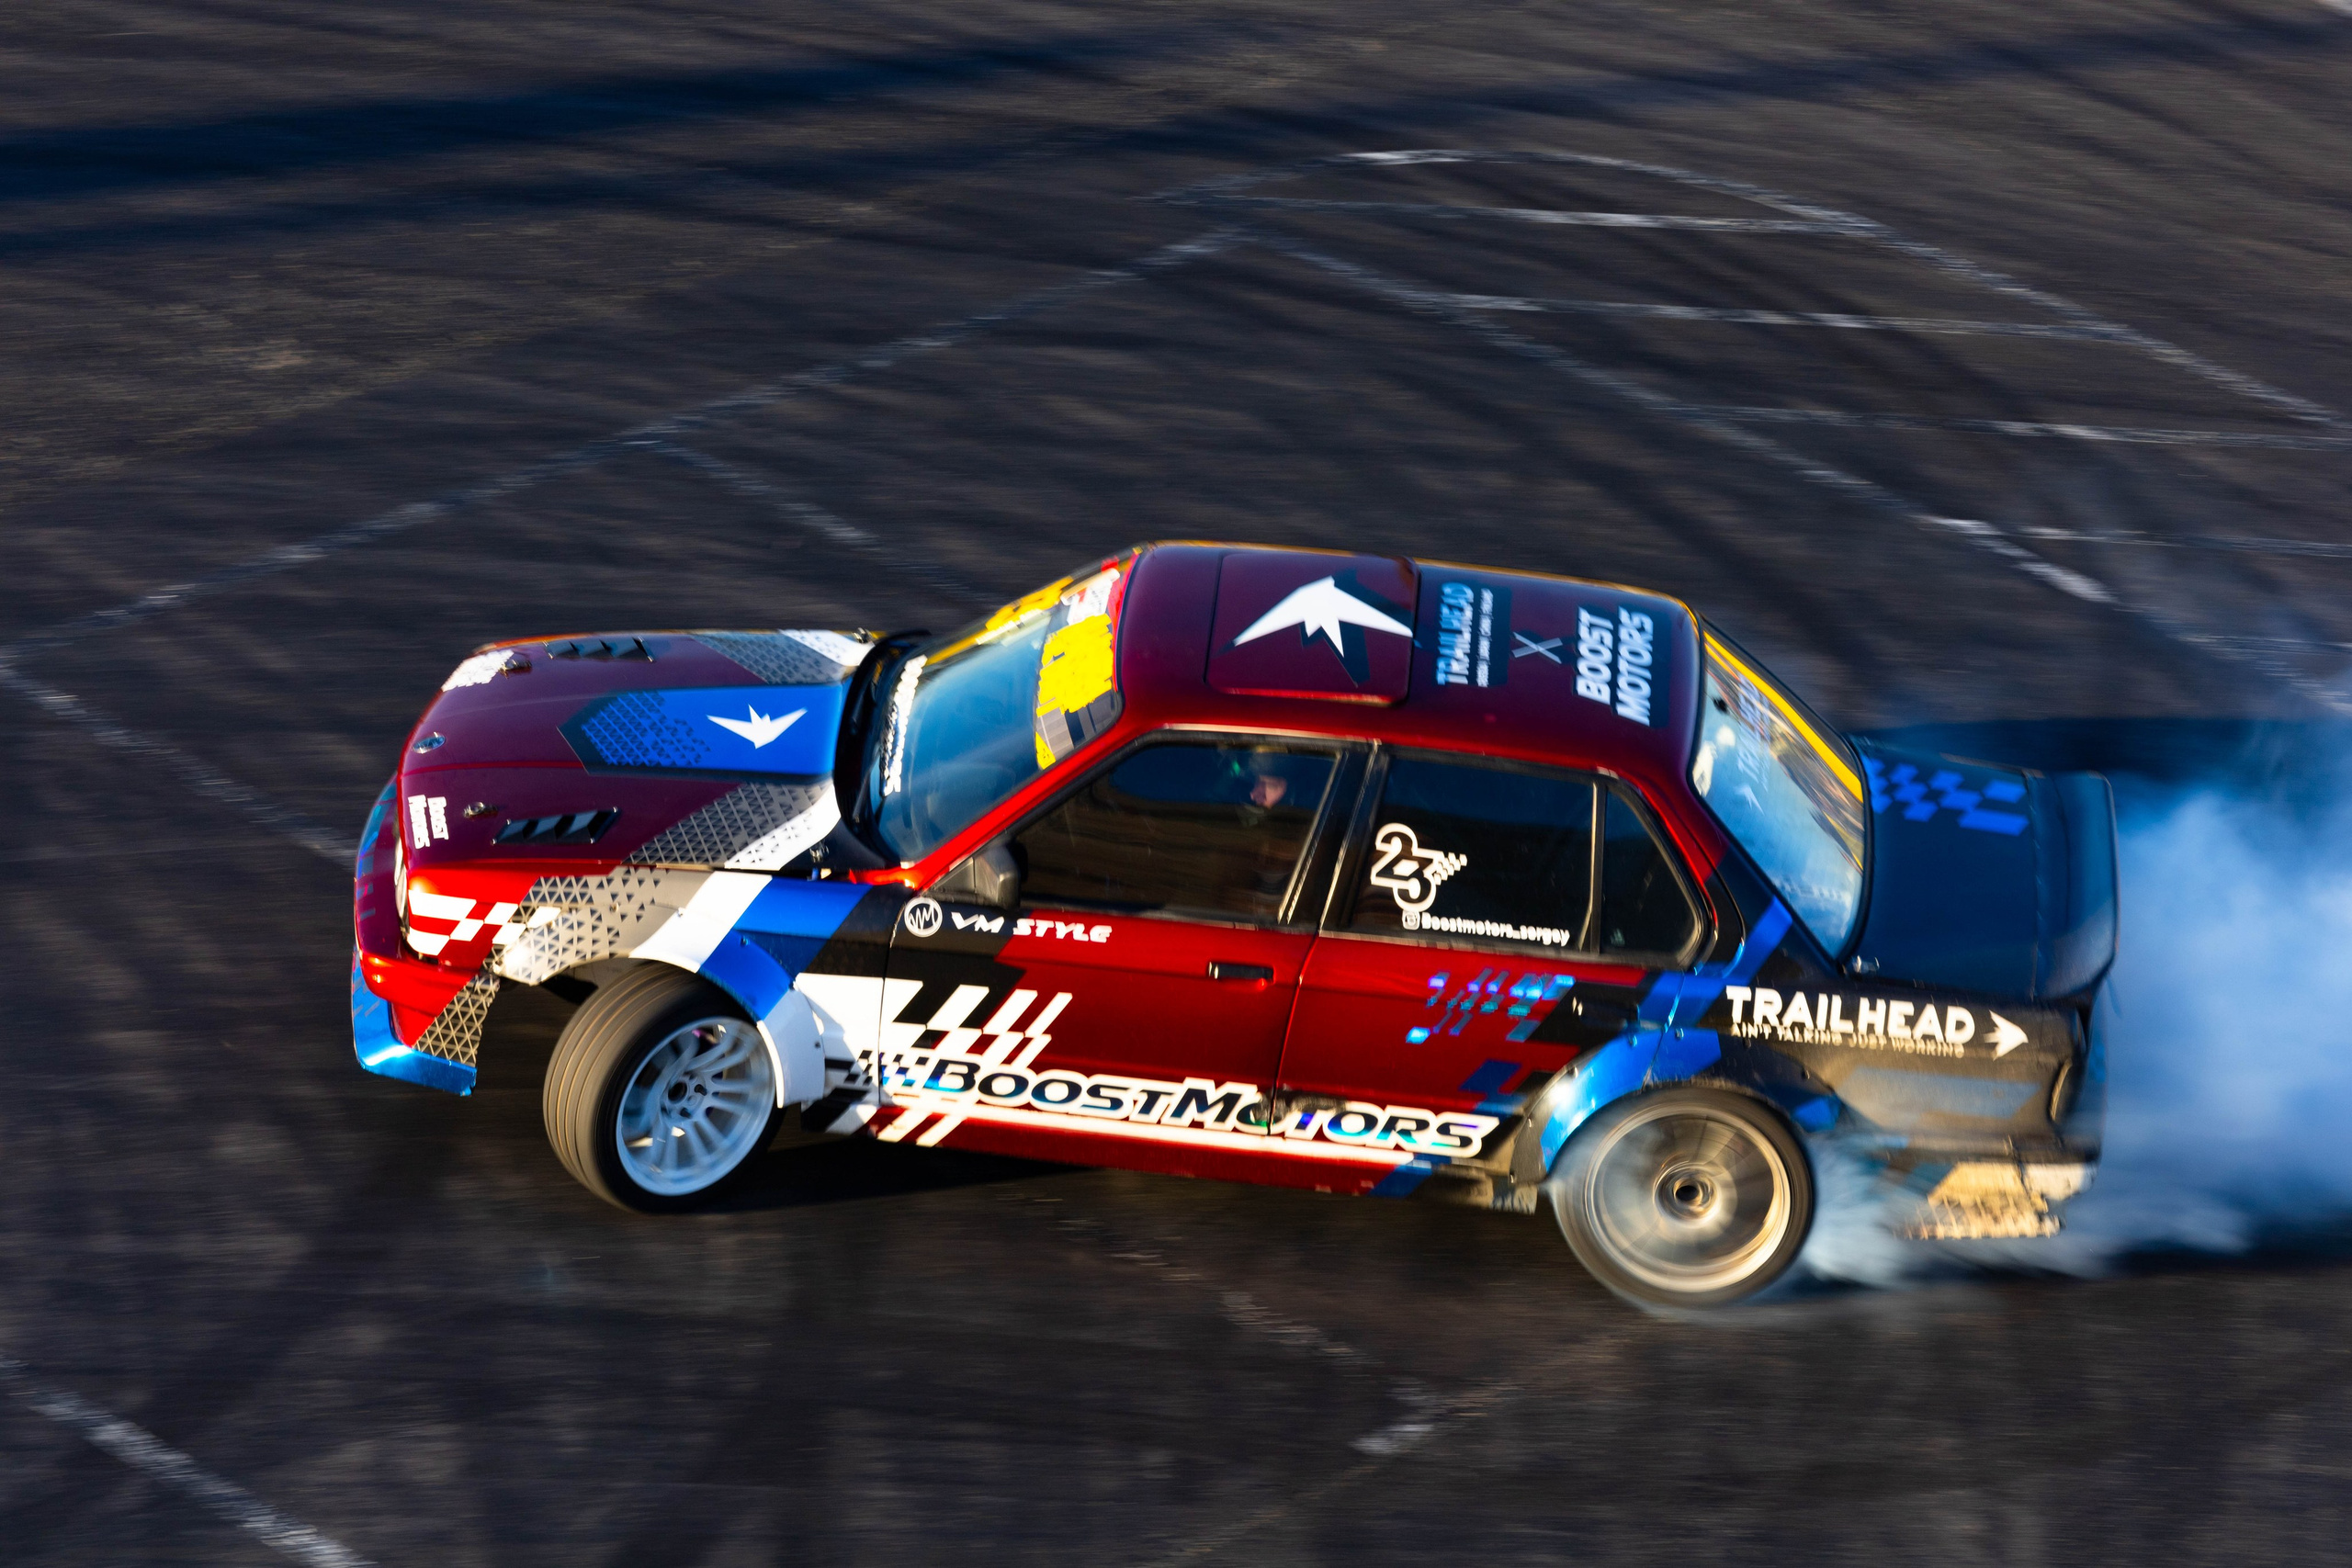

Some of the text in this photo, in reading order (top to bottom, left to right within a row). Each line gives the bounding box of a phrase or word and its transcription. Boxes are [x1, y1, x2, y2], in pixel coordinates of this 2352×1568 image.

[1436, 582, 1474, 685] TRAILHEAD
[1576, 605, 1614, 705] BOOST
[1615, 605, 1653, 726] MOTORS
[951, 911, 1113, 943] VM STYLE
[1725, 985, 1976, 1044] TRAILHEAD
